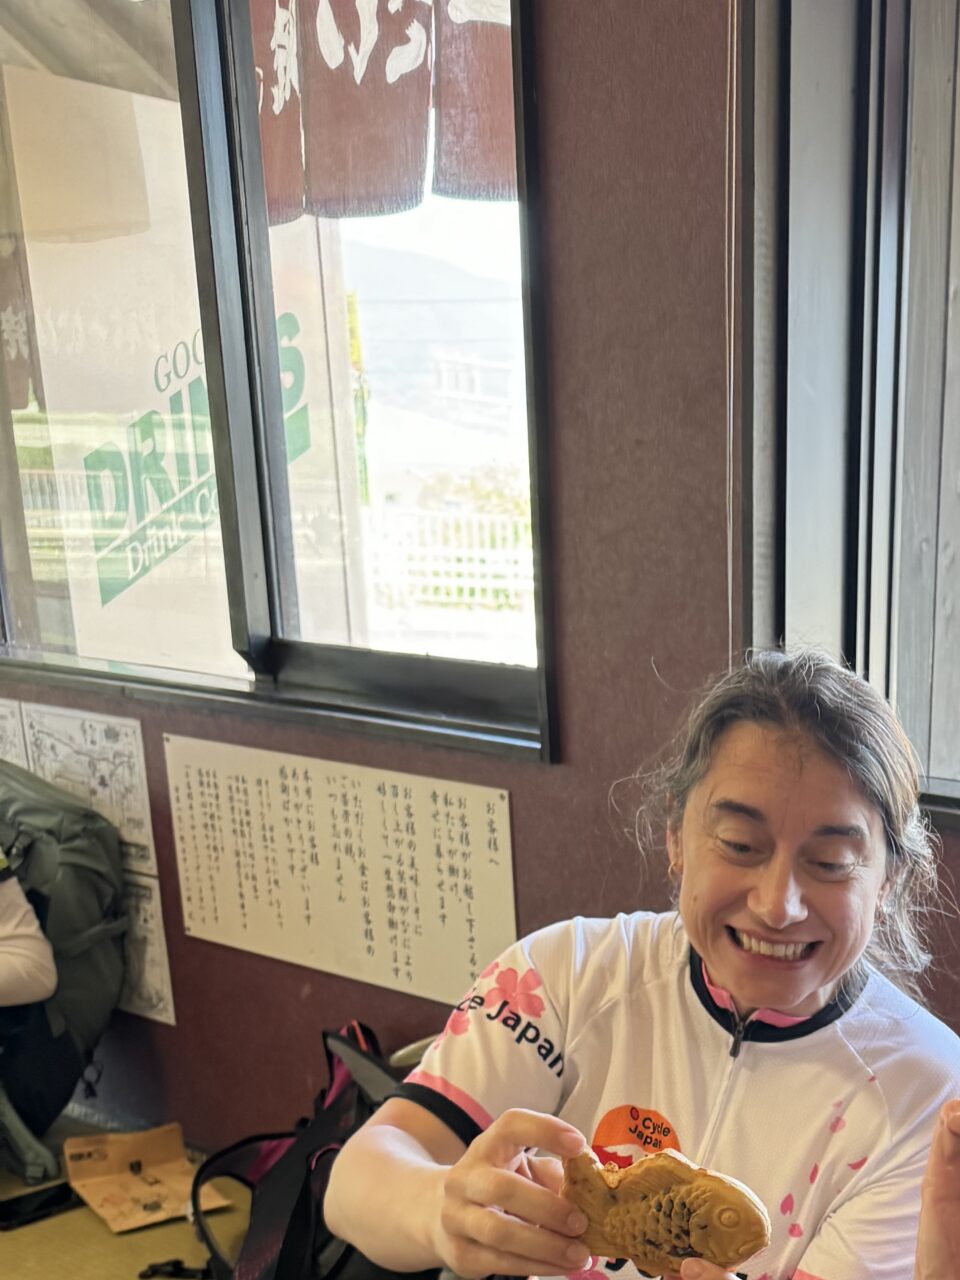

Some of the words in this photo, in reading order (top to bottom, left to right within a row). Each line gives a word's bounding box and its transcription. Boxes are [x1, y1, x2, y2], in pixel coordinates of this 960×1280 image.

[486, 802, 500, 866] お客様へ
[486, 1000, 564, 1078] Japan
[642, 1117, 670, 1138] Cycle
